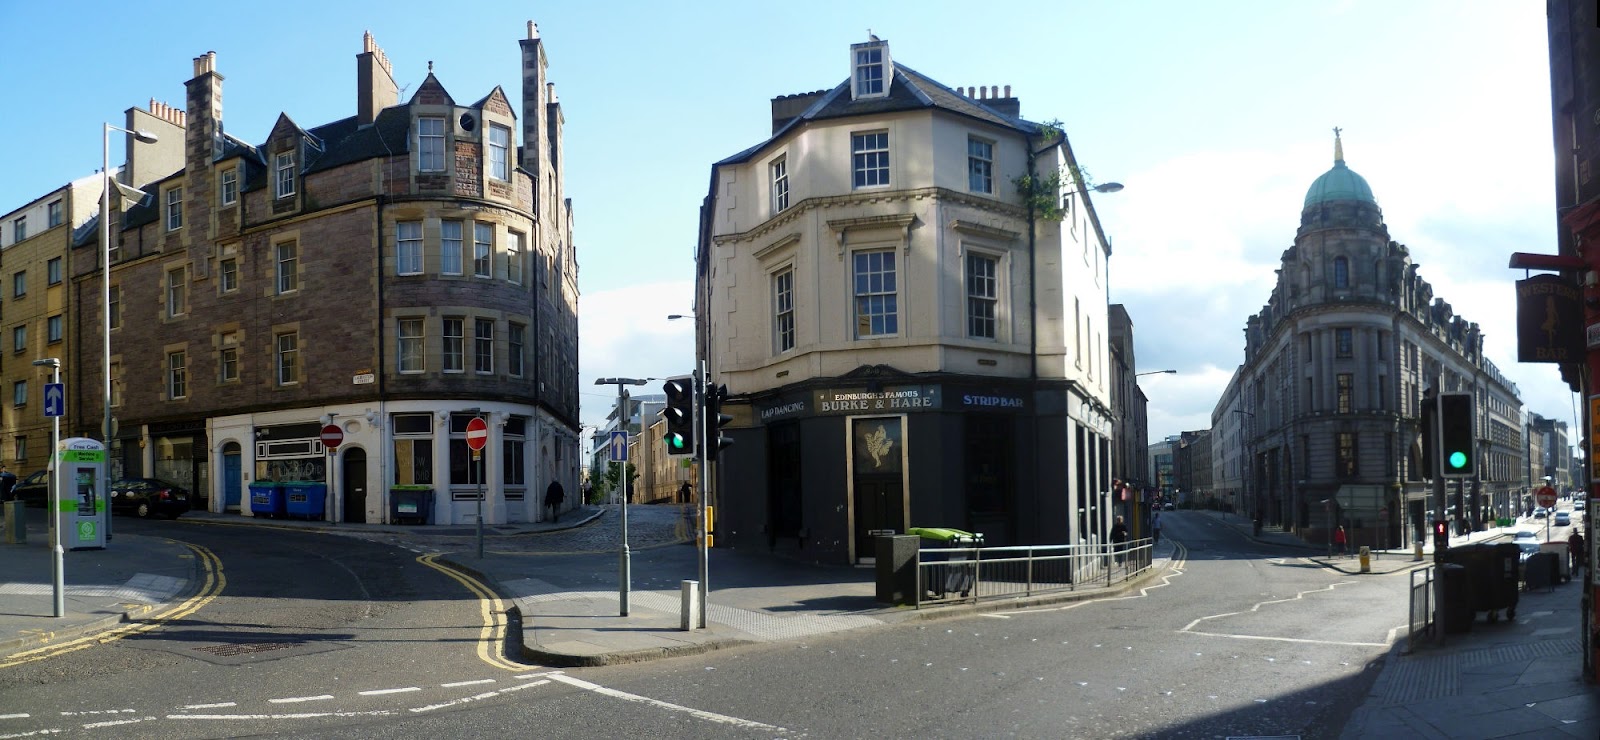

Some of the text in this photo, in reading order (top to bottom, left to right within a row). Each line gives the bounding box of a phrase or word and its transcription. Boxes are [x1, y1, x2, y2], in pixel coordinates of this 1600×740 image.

[1519, 283, 1579, 301] WESTERN
[1535, 346, 1569, 360] BAR
[885, 390, 918, 399] FAMOUS
[963, 395, 1024, 408] STRIP BAR
[761, 401, 804, 419] LAP DANCING
[822, 397, 932, 412] BURKE & HARE
